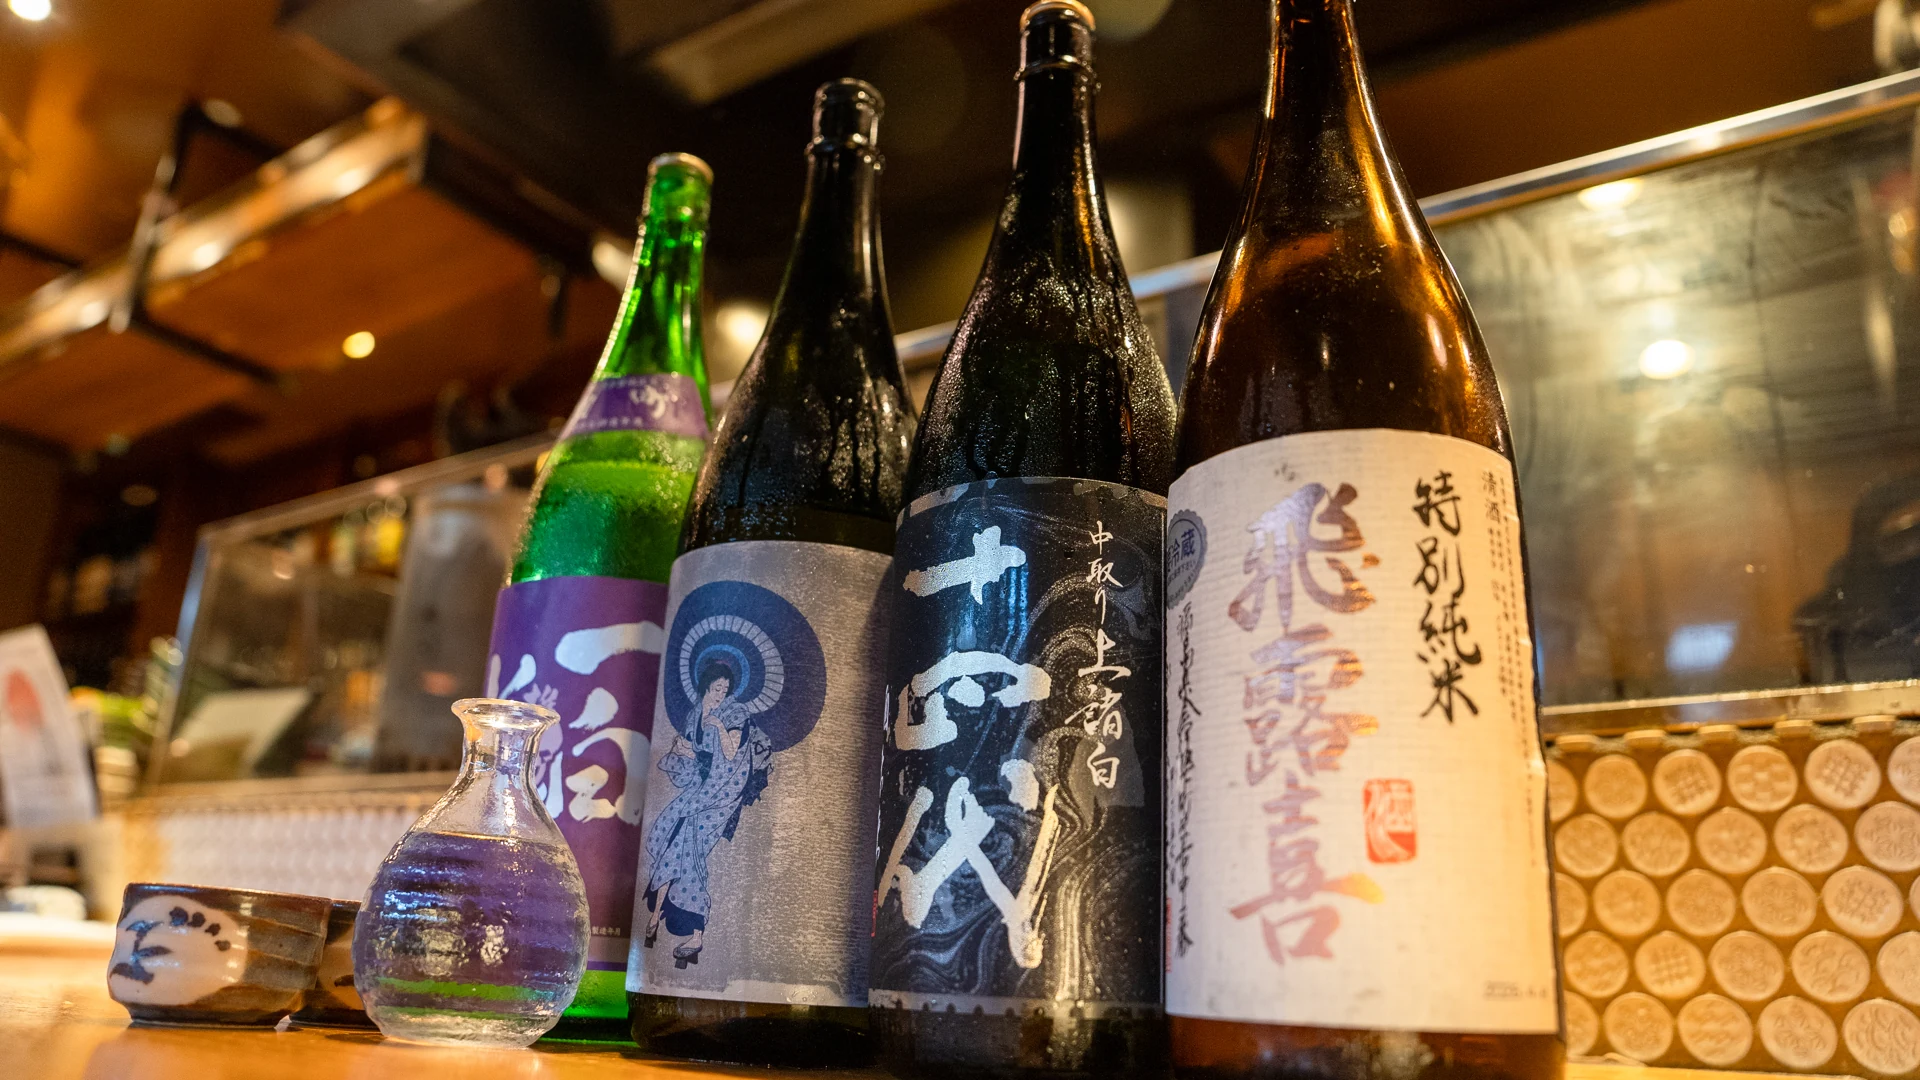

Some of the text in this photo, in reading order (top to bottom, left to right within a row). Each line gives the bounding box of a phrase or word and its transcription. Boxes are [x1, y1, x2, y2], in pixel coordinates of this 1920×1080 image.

[1411, 470, 1482, 724] 特別純米
[1481, 471, 1500, 524] 清酒
[878, 525, 1060, 969] 十四代
[1065, 520, 1131, 789] 中取り上諸白
[1229, 482, 1385, 966] 飛露喜
